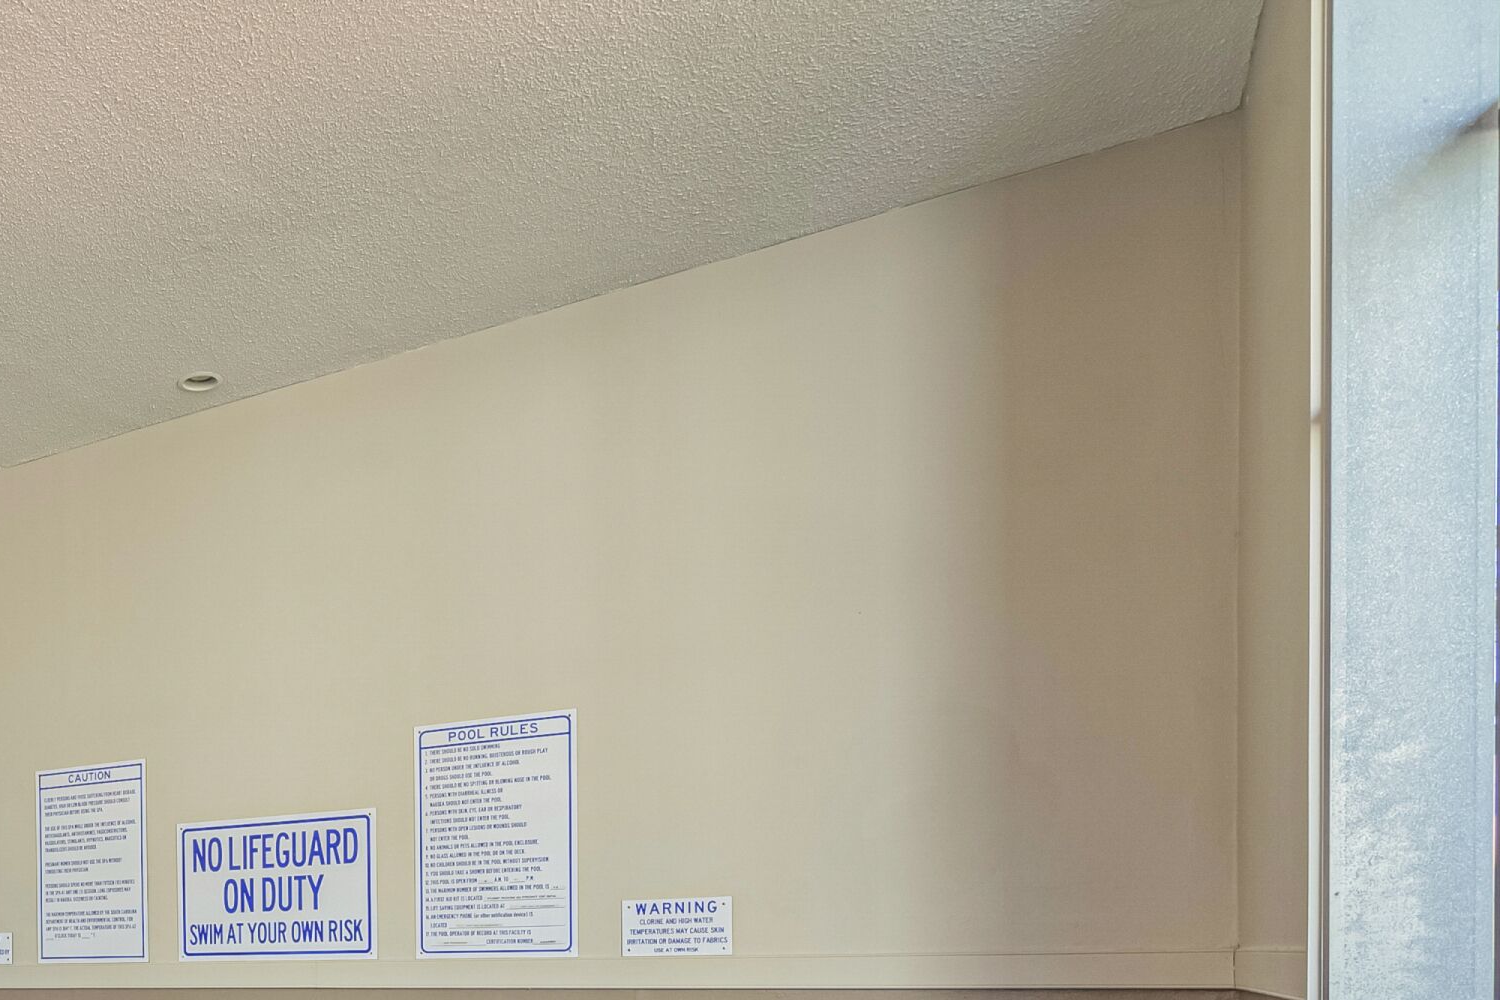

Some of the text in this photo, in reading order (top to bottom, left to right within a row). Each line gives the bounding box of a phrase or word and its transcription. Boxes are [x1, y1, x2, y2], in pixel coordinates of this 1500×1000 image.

[448, 722, 538, 741] POOL RULES
[68, 771, 111, 783] CAUTION
[193, 828, 358, 872] NO LIFEGUARD
[224, 874, 324, 913] ON DUTY
[636, 900, 717, 915] WARNING
[190, 919, 363, 945] SWIM AT YOUR OWN RISK
